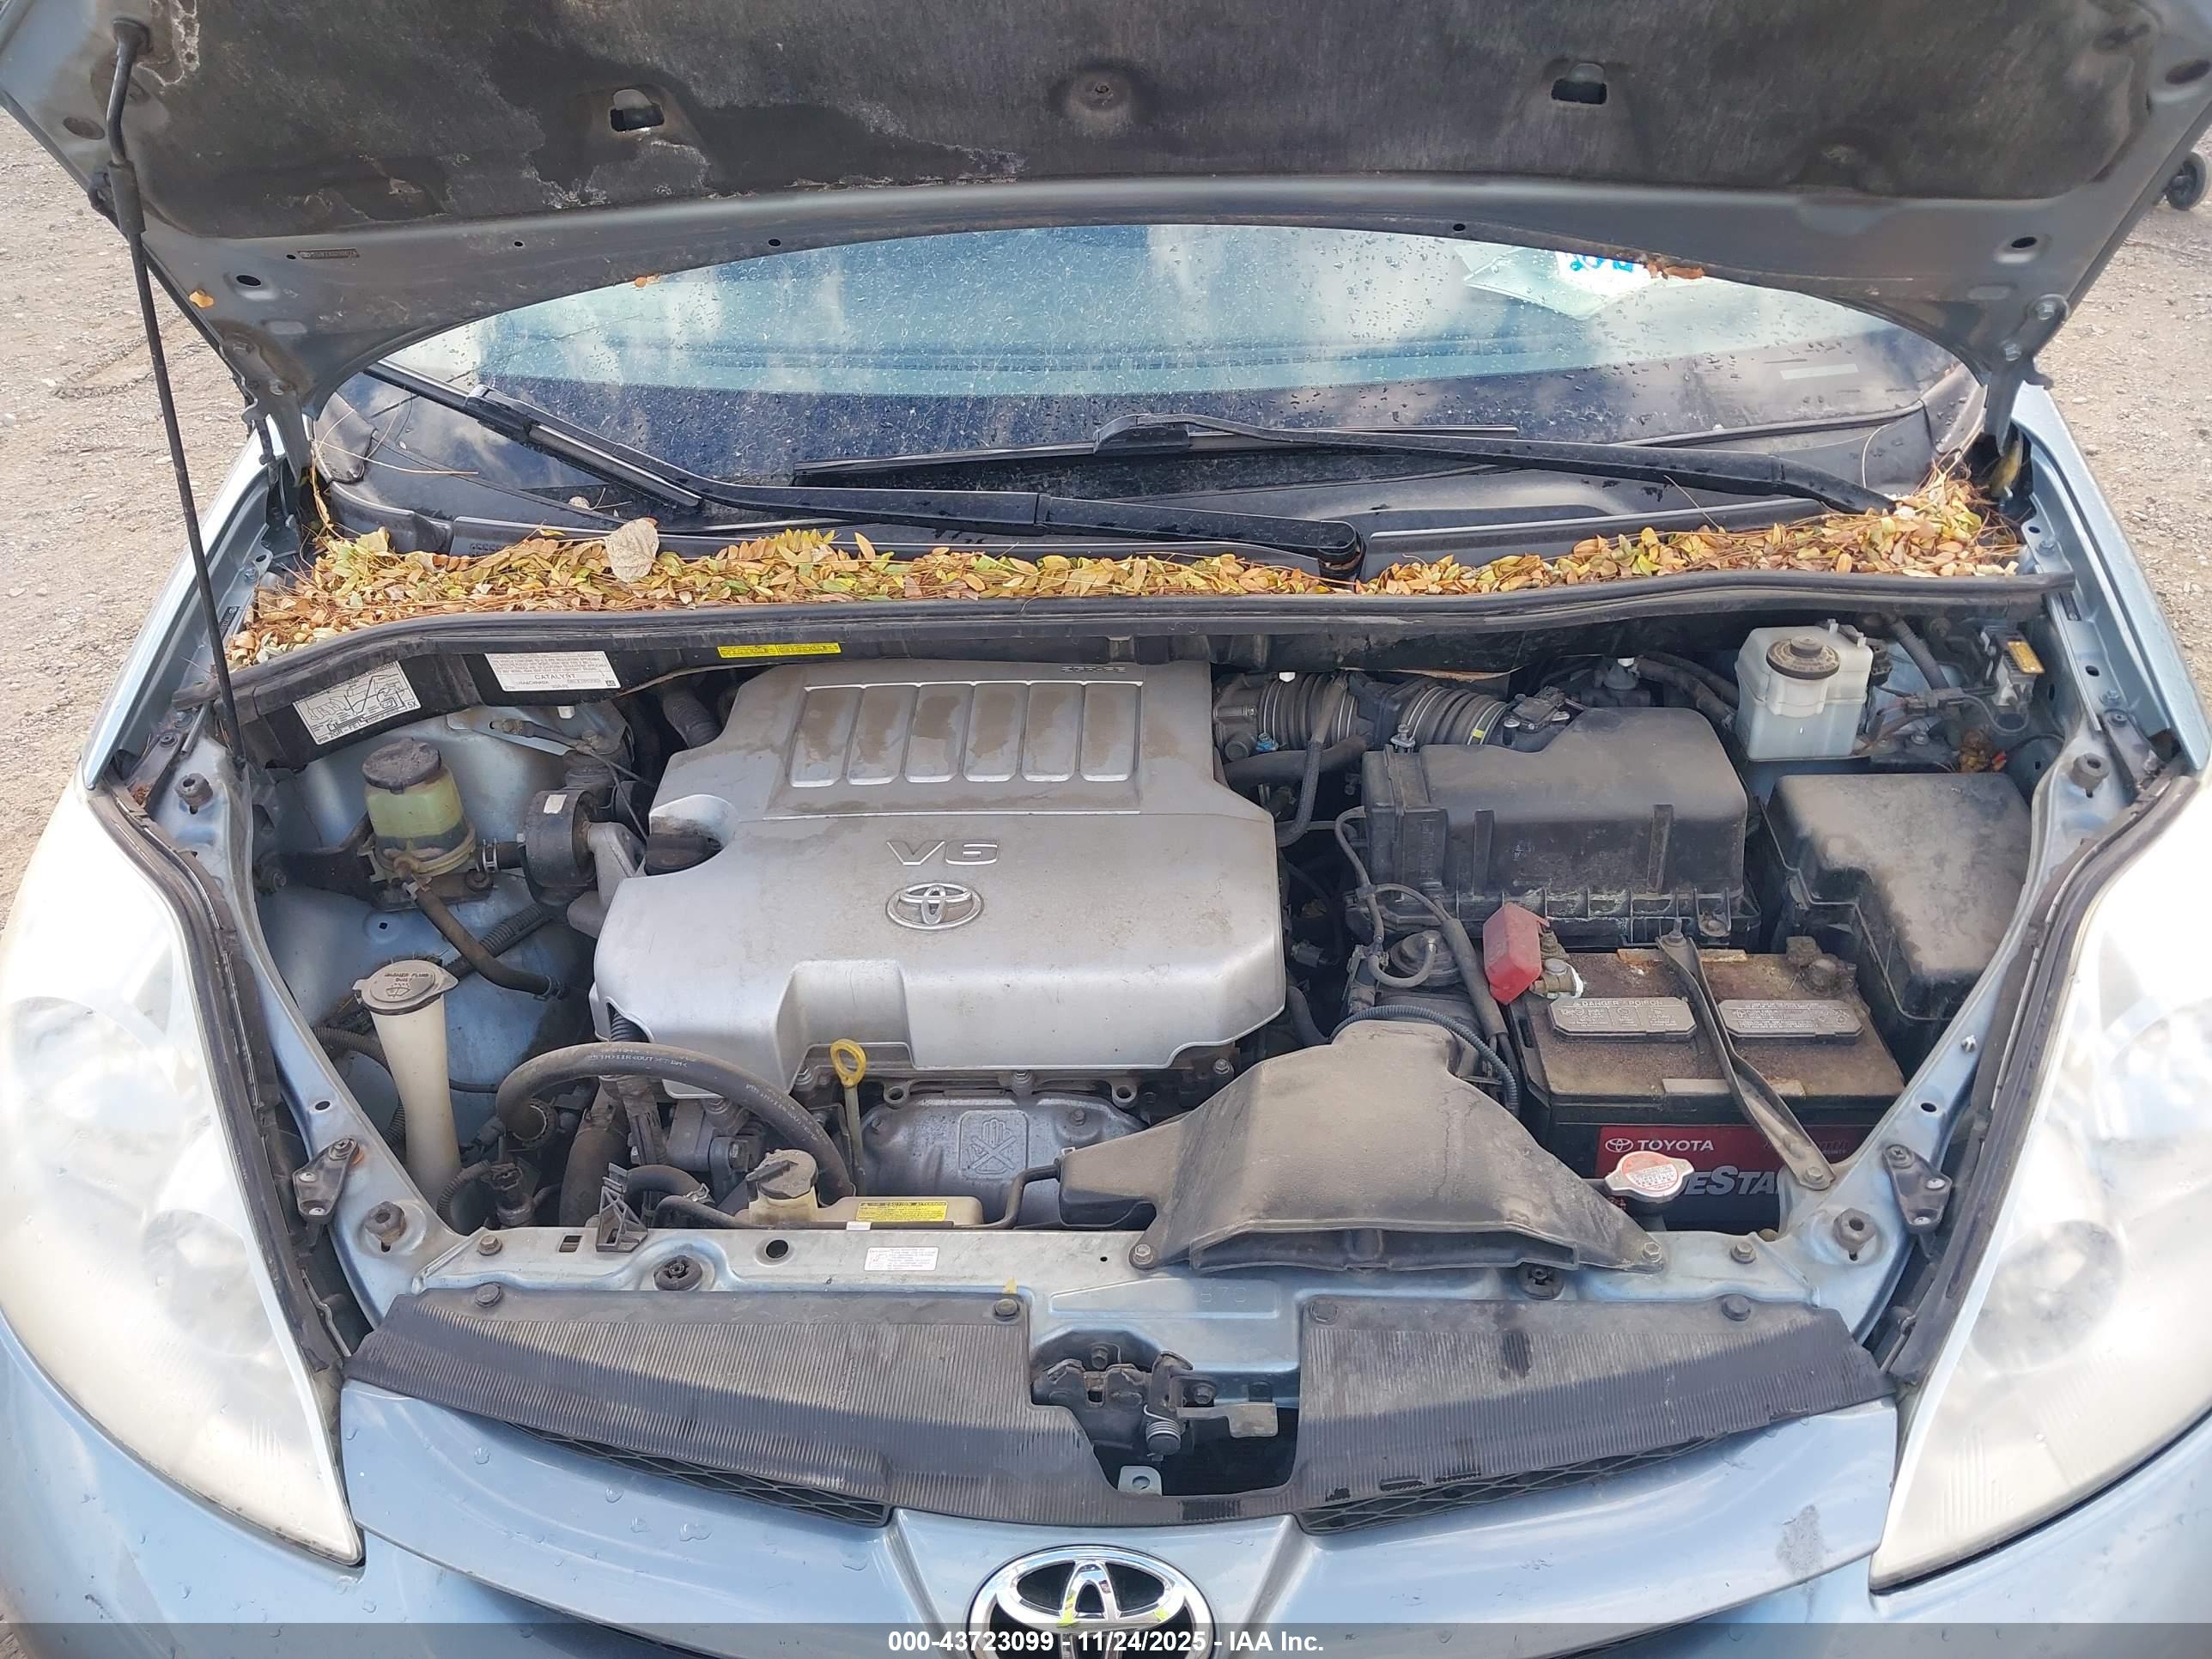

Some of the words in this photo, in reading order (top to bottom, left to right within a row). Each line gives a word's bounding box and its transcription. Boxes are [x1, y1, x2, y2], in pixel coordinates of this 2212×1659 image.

[407, 700, 419, 709] 5X
[886, 839, 999, 866] V6
[1637, 1139, 1715, 1152] TOYOTA
